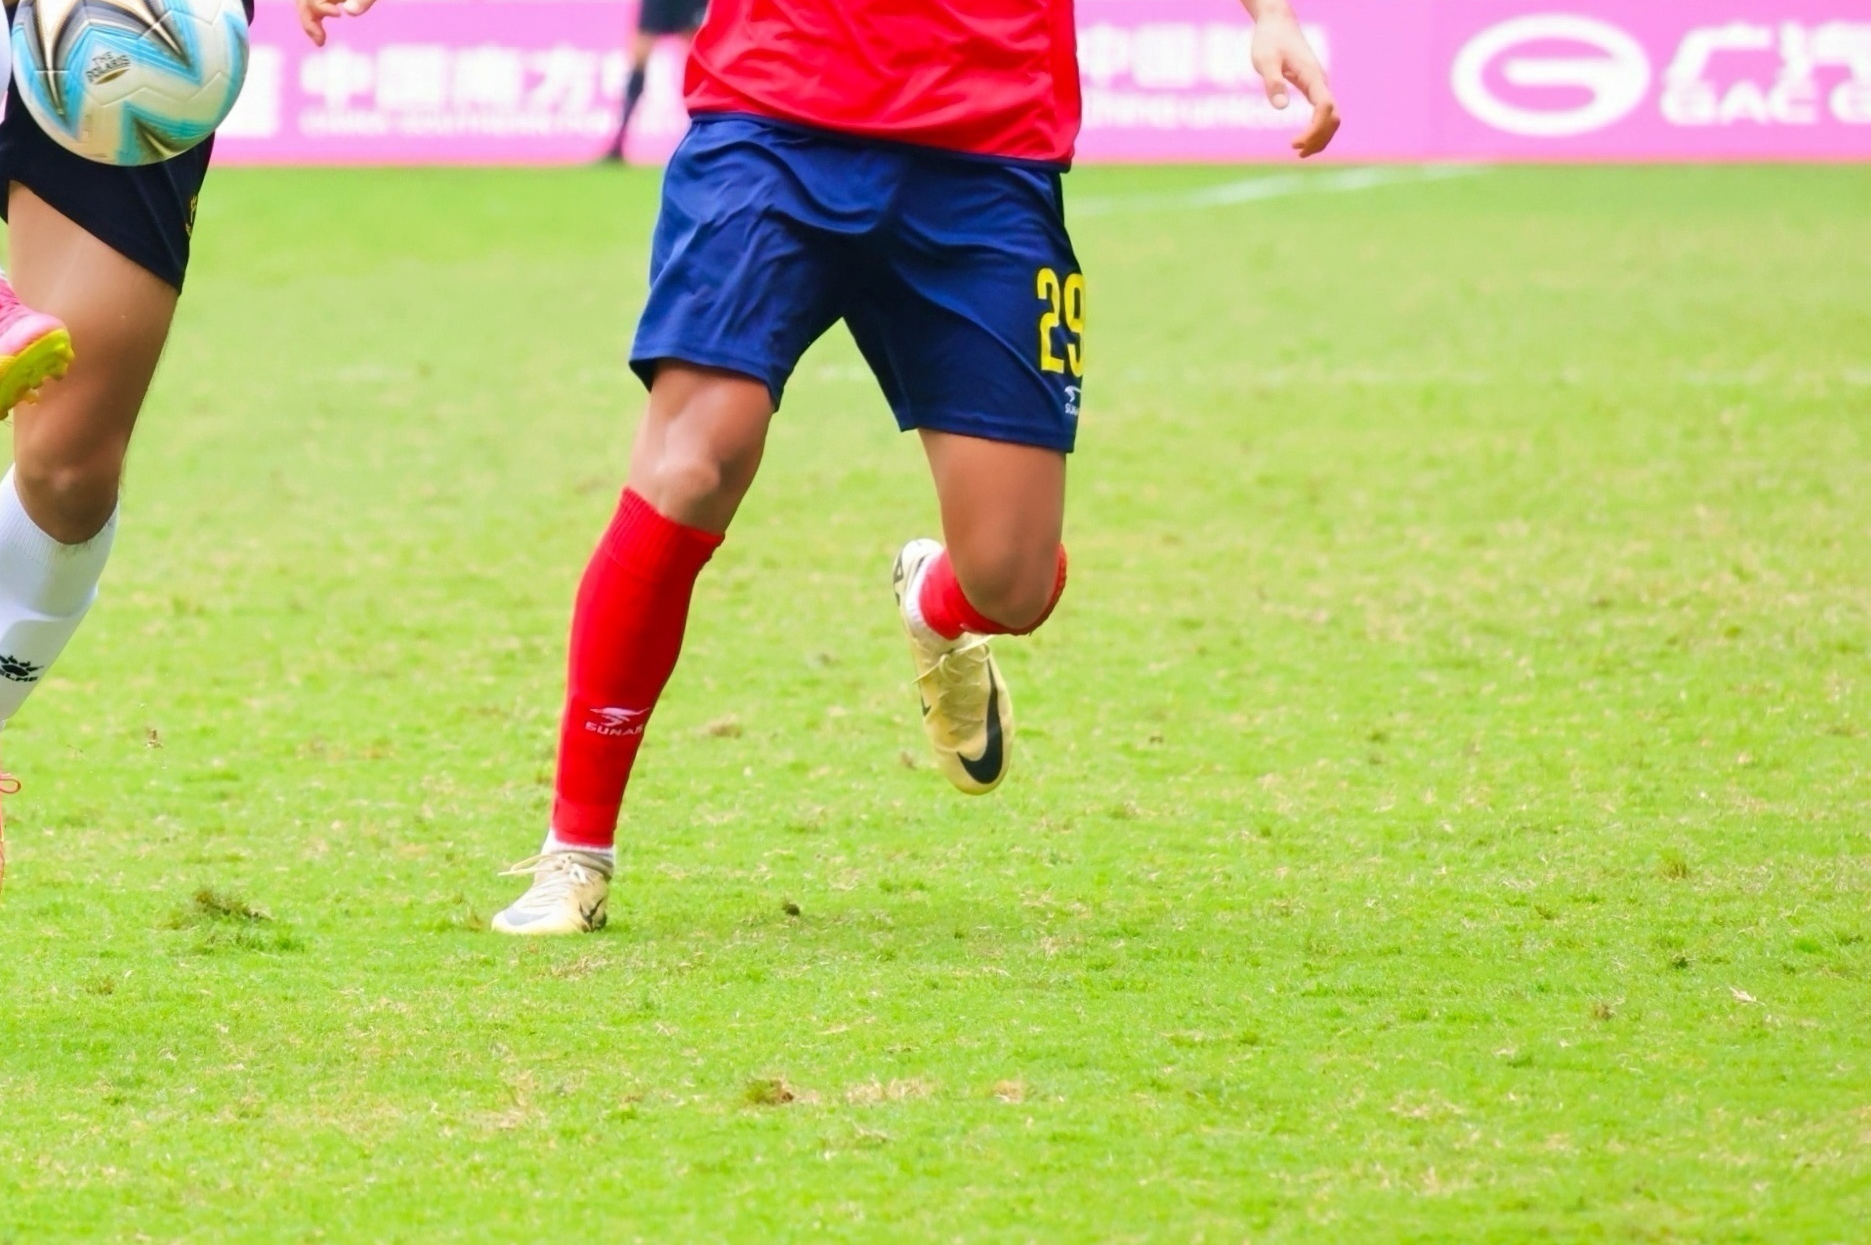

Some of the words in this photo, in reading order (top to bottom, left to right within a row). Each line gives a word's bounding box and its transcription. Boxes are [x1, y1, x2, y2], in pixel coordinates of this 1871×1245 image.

[85, 54, 131, 83] POLARIS
[1659, 79, 1820, 126] GAC
[1037, 267, 1087, 378] 29
